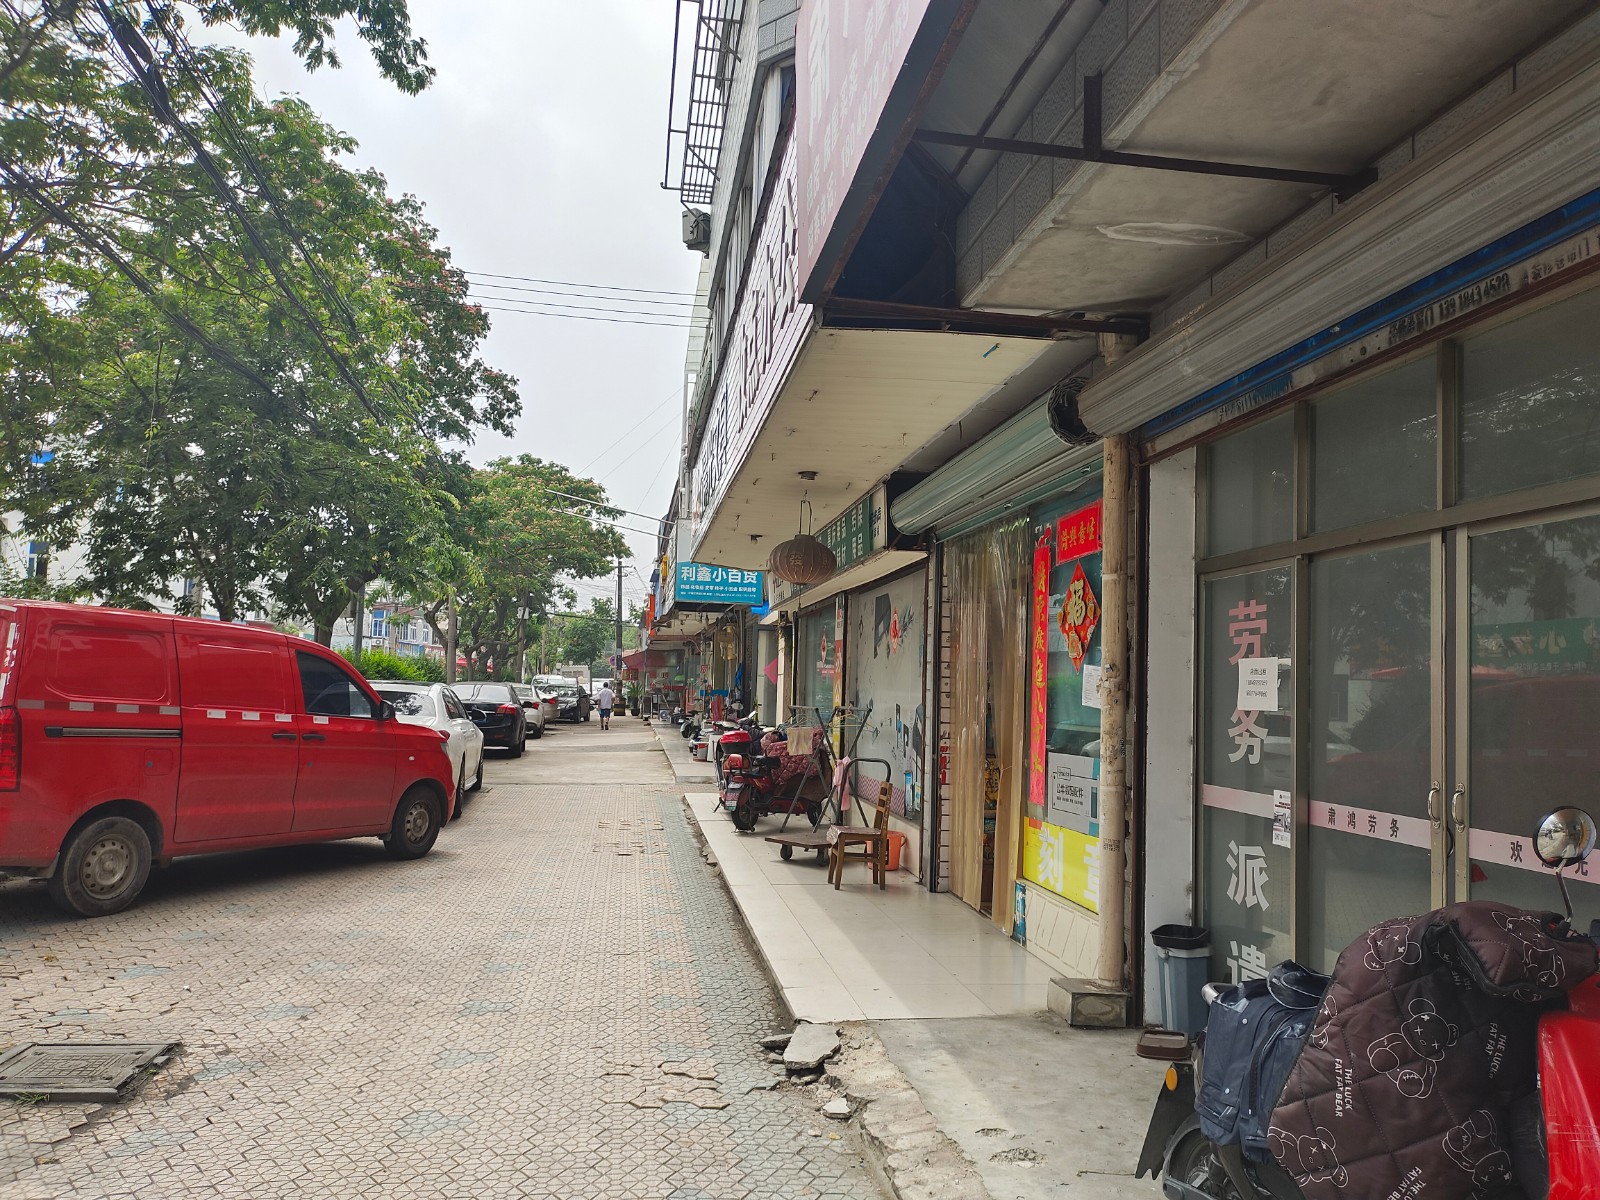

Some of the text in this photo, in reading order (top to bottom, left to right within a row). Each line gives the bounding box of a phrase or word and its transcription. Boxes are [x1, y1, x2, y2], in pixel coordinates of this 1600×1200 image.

[681, 566, 757, 584] 利鑫小百货
[1327, 807, 1400, 838] 肃鸿劳务
[1489, 1022, 1498, 1039] FAT
[1334, 1058, 1344, 1118] FAT FAT BEAR
[1344, 1067, 1354, 1110] THE LUCK
[1407, 1166, 1423, 1182] FAT
[1397, 1177, 1411, 1193] FAT
[1410, 1180, 1427, 1195] THE
